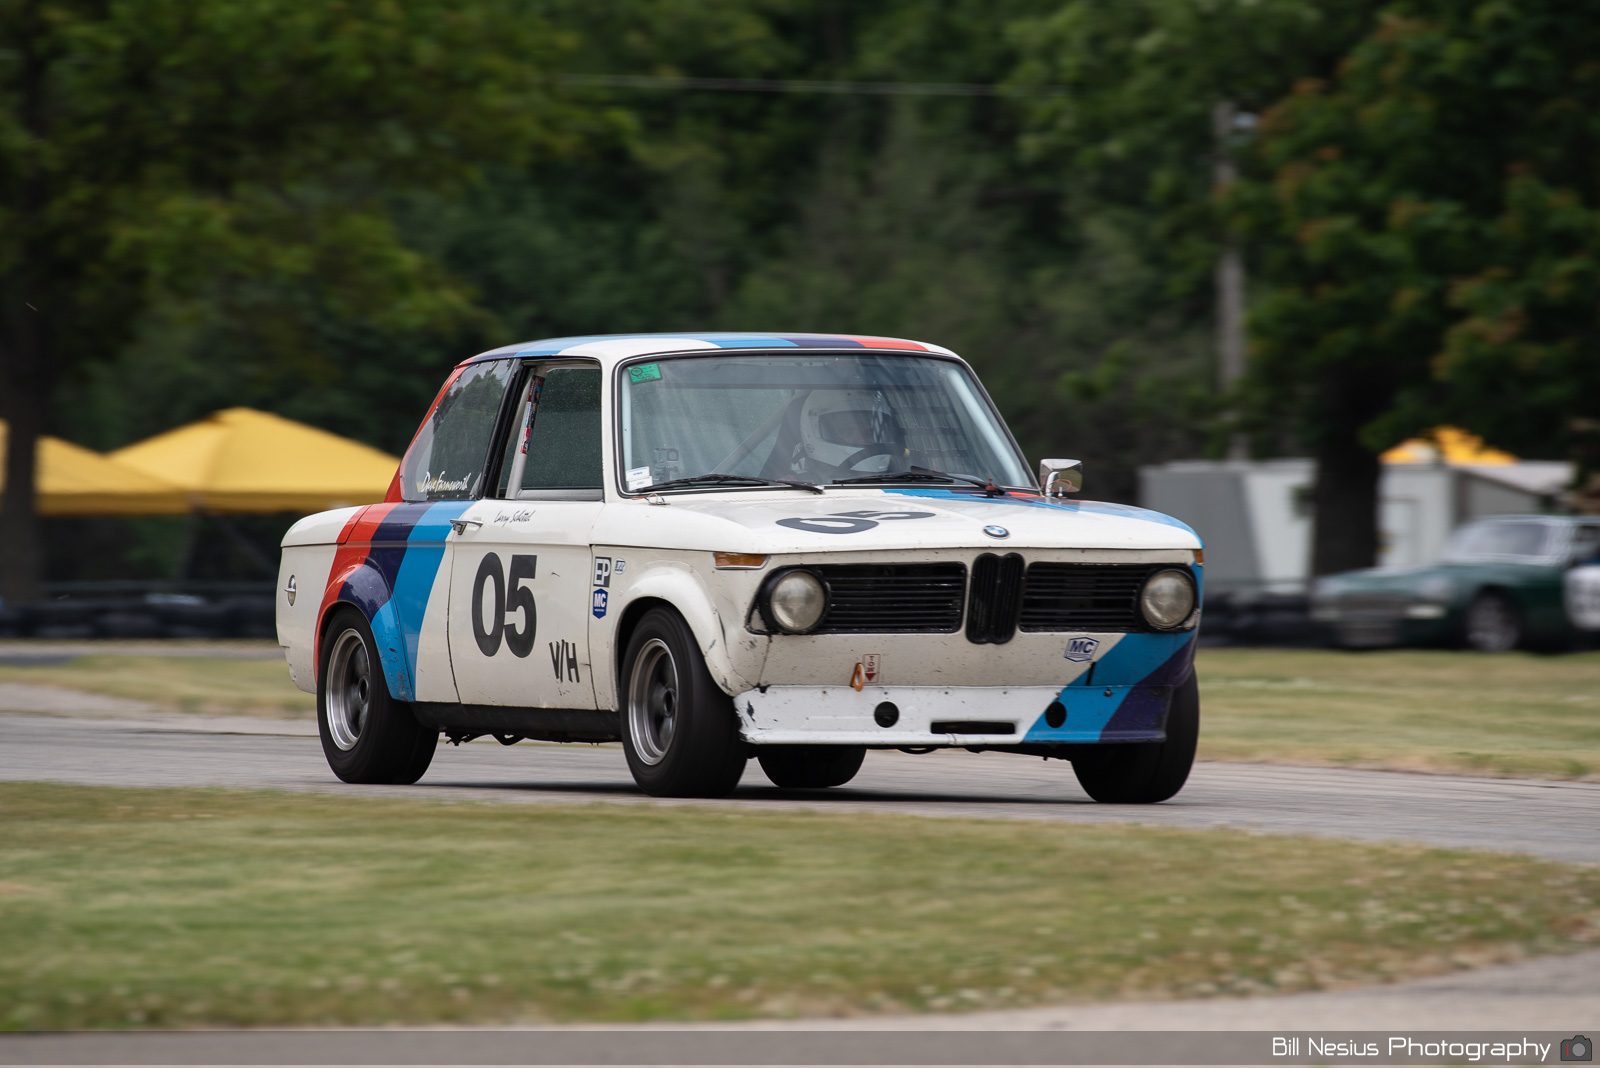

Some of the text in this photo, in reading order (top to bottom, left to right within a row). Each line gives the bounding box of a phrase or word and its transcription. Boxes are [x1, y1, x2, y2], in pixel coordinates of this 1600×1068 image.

[775, 510, 937, 535] 05
[593, 558, 611, 585] EP
[471, 551, 537, 659] 05
[593, 593, 607, 608] MC
[1069, 640, 1095, 653] MC
[867, 655, 876, 673] TOW
